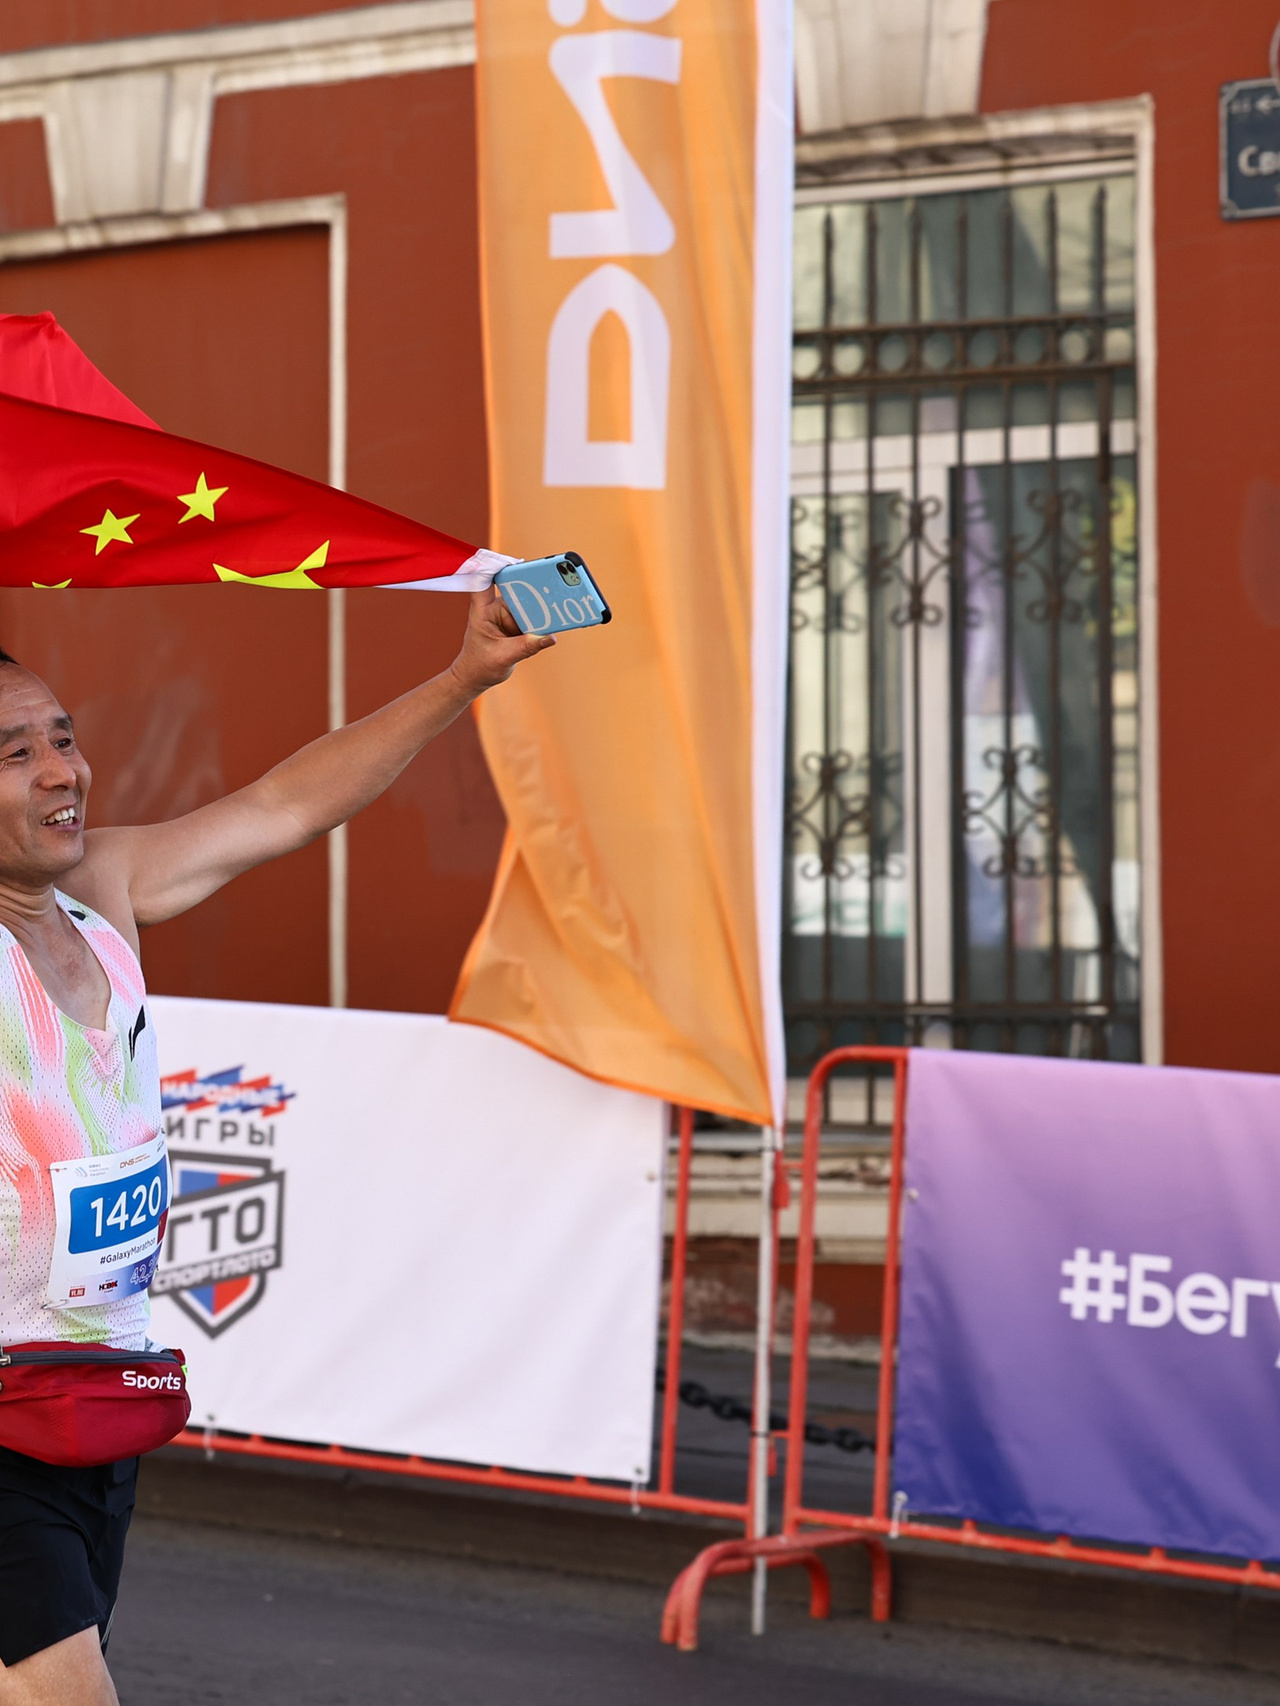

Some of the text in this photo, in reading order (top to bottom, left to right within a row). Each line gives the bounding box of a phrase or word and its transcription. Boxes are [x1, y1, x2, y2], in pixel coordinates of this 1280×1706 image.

[499, 580, 601, 633] Dior
[166, 1115, 275, 1147] ИГРЫ
[90, 1176, 162, 1238] 1420
[166, 1197, 265, 1262] ГТО
[100, 1237, 156, 1265] #GalaxyMarathon
[1059, 1246, 1280, 1369] #Бег
[122, 1370, 181, 1390] Sports
